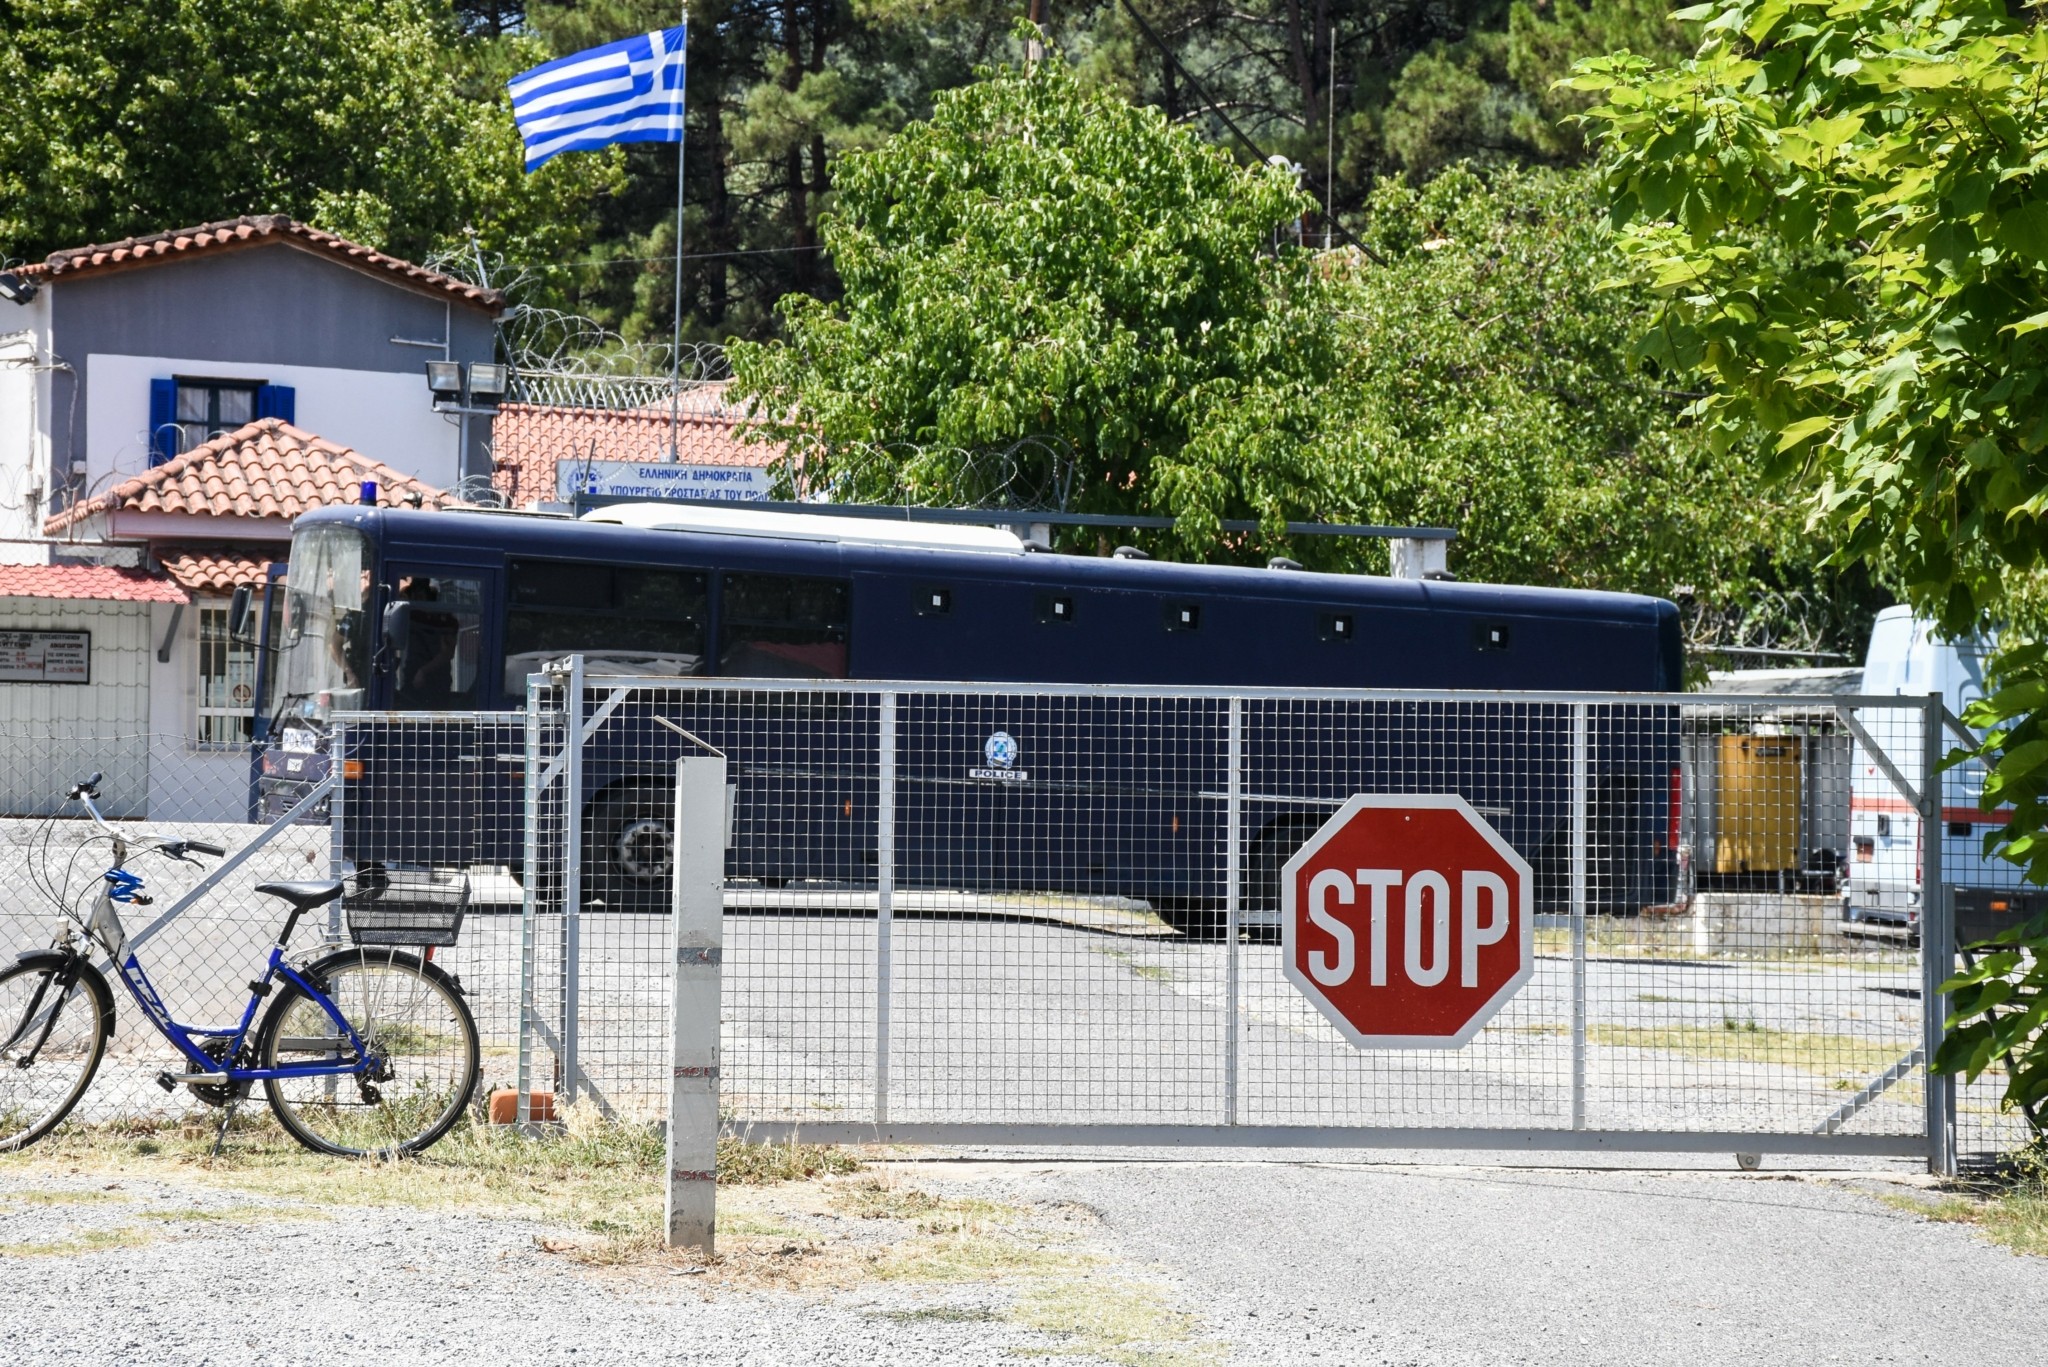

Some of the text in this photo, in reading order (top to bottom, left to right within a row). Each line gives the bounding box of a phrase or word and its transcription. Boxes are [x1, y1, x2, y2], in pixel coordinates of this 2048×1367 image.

[639, 467, 687, 480] ΕΛΛΗΝΙΚΗ
[724, 489, 742, 500] ΤΟΥ
[974, 770, 1023, 779] POLICE
[1308, 868, 1510, 988] STOP
